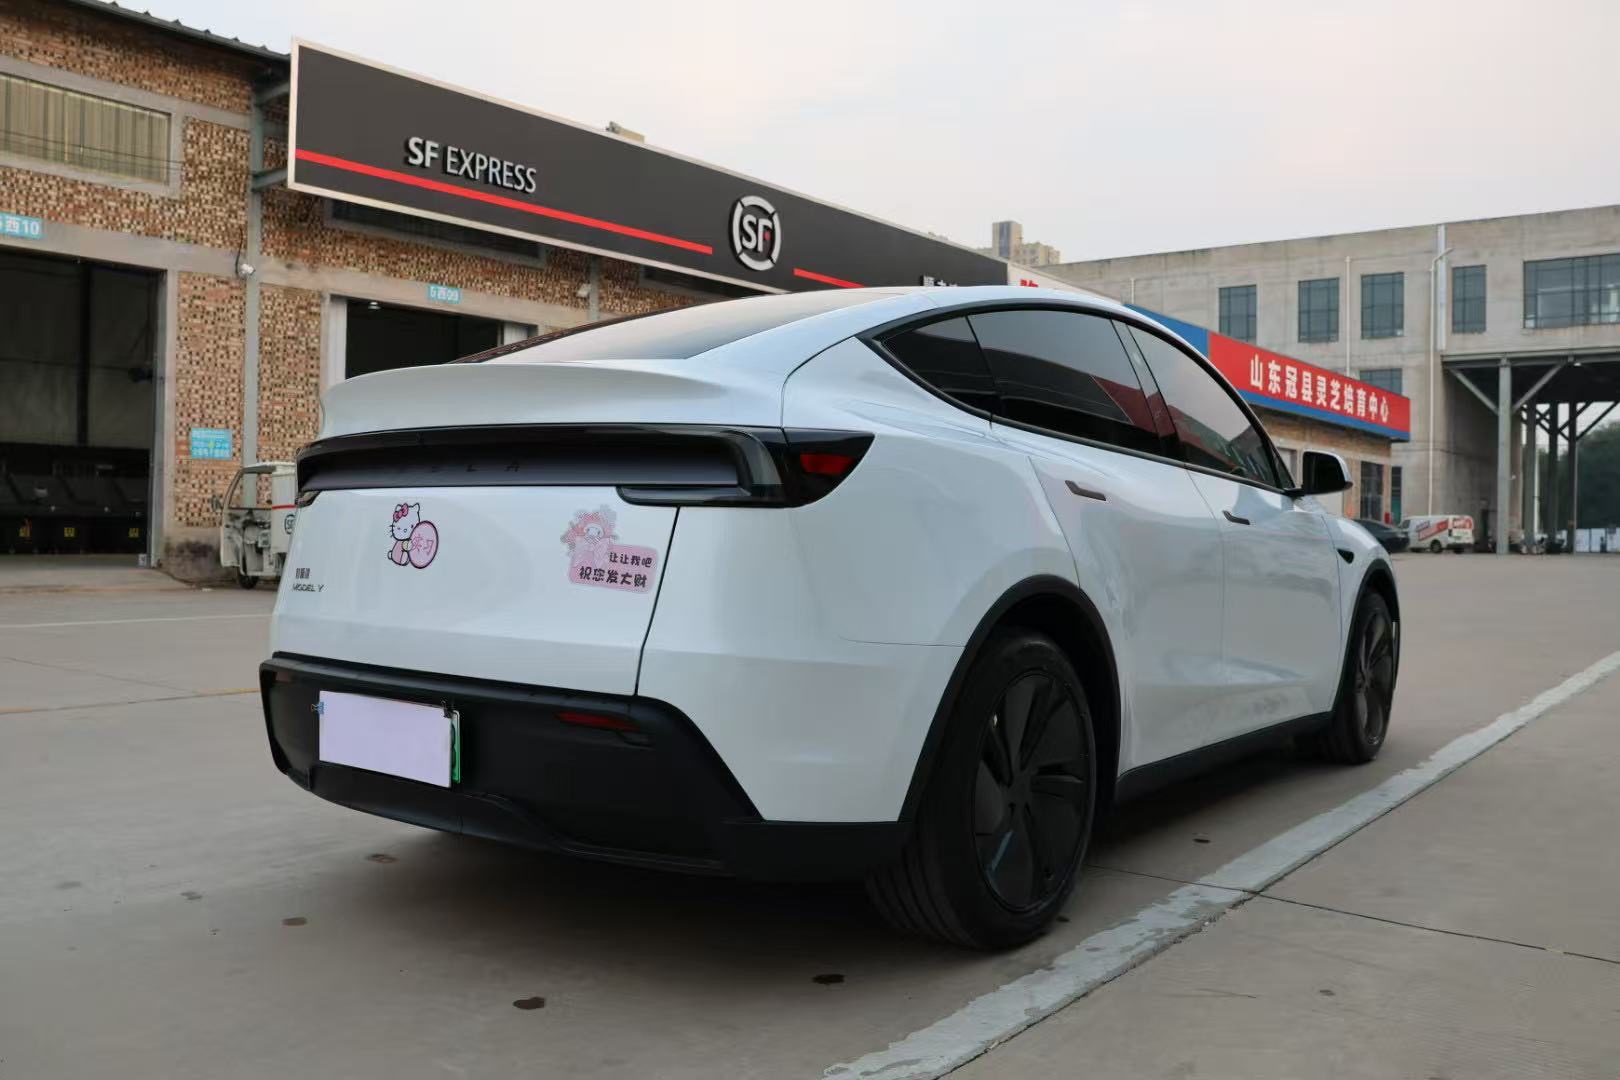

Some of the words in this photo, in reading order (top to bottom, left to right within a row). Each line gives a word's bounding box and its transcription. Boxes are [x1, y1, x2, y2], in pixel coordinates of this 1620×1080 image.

[408, 136, 439, 167] SF
[446, 145, 536, 193] EXPRESS
[0, 215, 41, 235] 西10
[742, 214, 773, 252] SF
[1249, 353, 1389, 423] 山东冠县灵芝培育中心
[411, 534, 435, 556] 实习
[608, 552, 654, 568] 让让我吧
[579, 565, 648, 588] 祝您发大财
